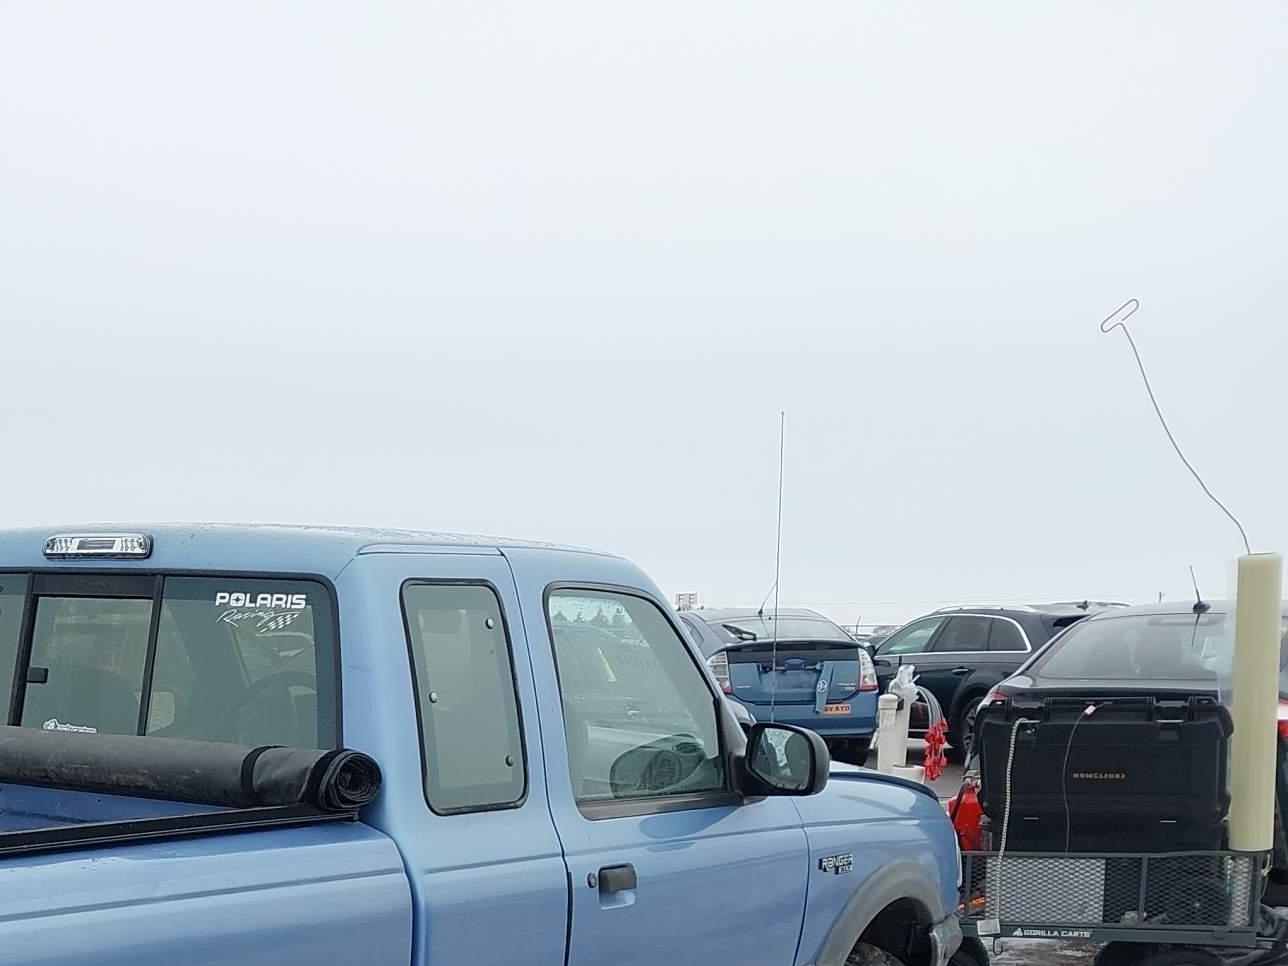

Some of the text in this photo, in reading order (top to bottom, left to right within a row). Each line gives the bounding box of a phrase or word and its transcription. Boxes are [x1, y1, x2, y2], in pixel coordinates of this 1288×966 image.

[215, 592, 307, 609] POLARIS
[821, 854, 853, 872] RANGER
[1023, 928, 1091, 938] GORILLA CARTS
